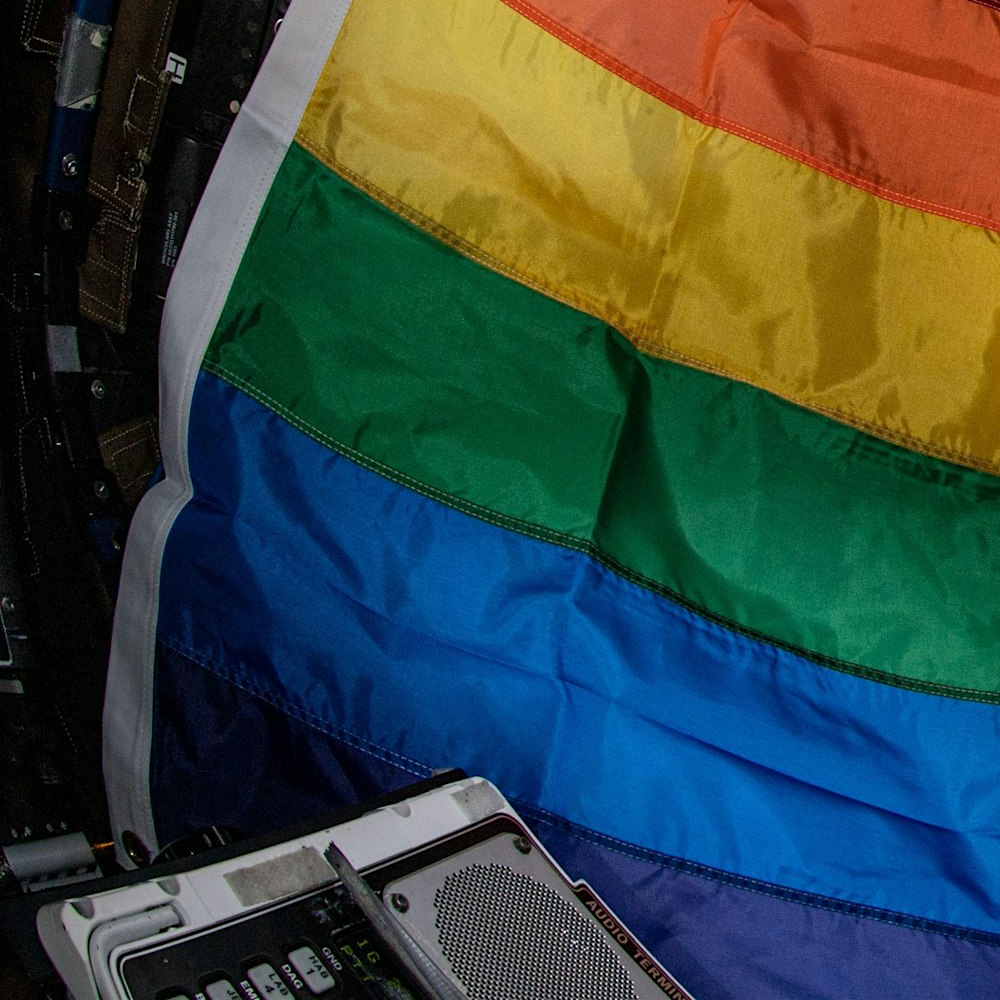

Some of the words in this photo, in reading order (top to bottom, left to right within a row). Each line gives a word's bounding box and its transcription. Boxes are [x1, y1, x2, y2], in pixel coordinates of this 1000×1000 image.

[167, 56, 185, 80] H
[585, 900, 628, 945] AUDIO
[308, 956, 329, 979] HAB
[322, 946, 342, 971] GND
[282, 964, 304, 989] DAG
[306, 968, 314, 976] 1
[240, 980, 261, 1000] EM
[264, 985, 274, 994] 4
[268, 973, 289, 996] LAB
